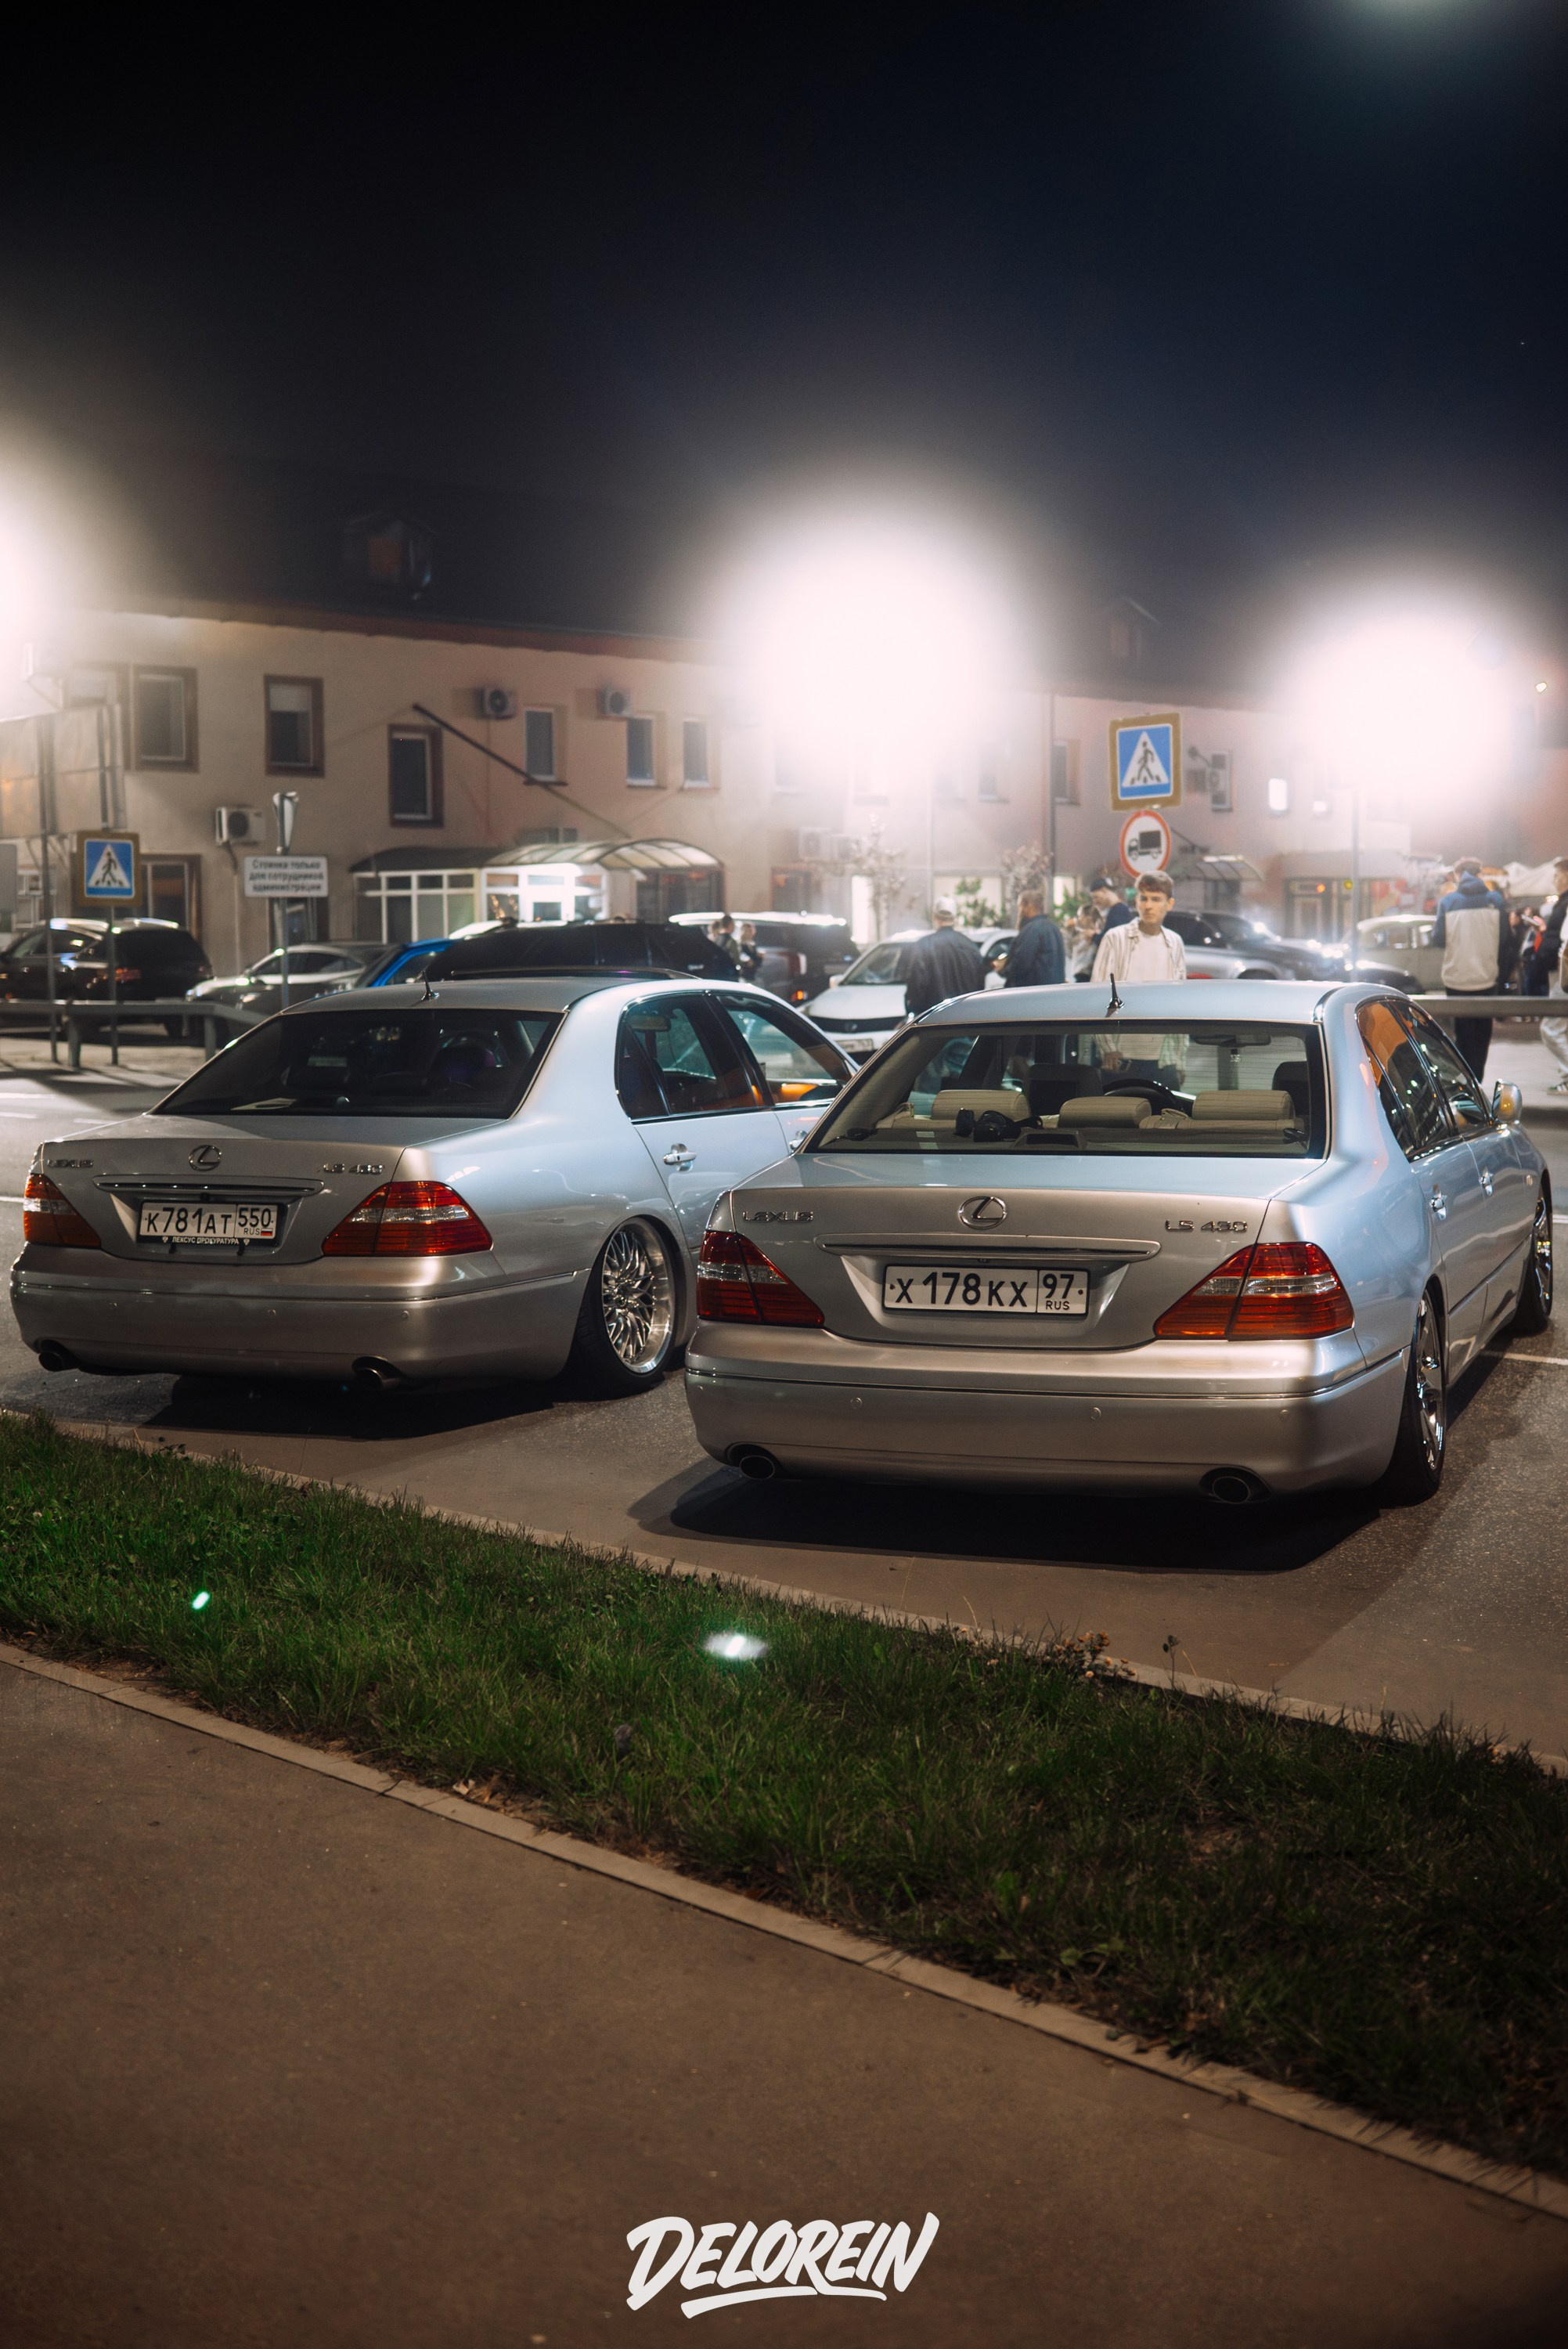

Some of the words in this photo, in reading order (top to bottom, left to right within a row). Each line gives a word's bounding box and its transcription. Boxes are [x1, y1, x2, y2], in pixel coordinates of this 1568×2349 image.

[238, 1207, 272, 1228] 550
[742, 1211, 814, 1223] LEXUS
[1165, 1219, 1195, 1232] LS
[1042, 1273, 1075, 1300] 97
[1045, 1300, 1070, 1311] RUS
